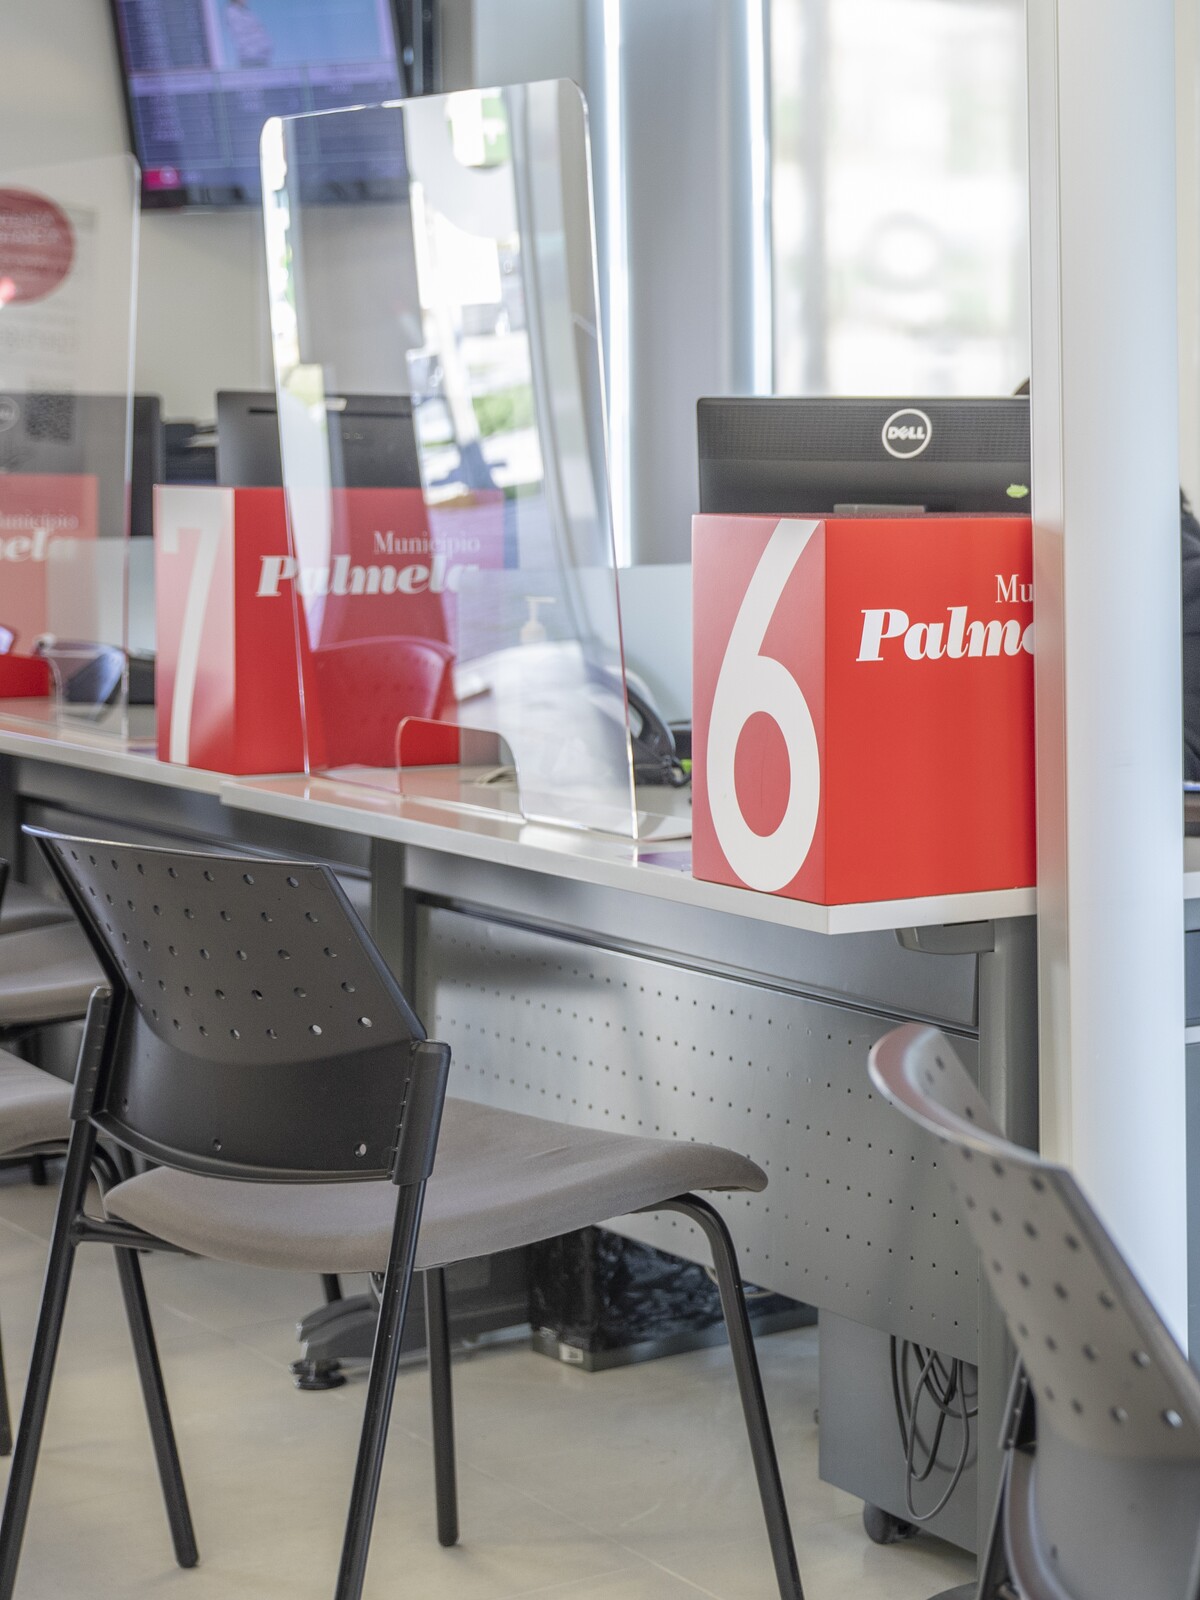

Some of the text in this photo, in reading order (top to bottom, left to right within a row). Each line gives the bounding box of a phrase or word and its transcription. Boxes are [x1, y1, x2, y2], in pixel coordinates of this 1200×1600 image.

[887, 426, 926, 440] DELL
[160, 487, 227, 766] 7
[706, 518, 821, 892] 6
